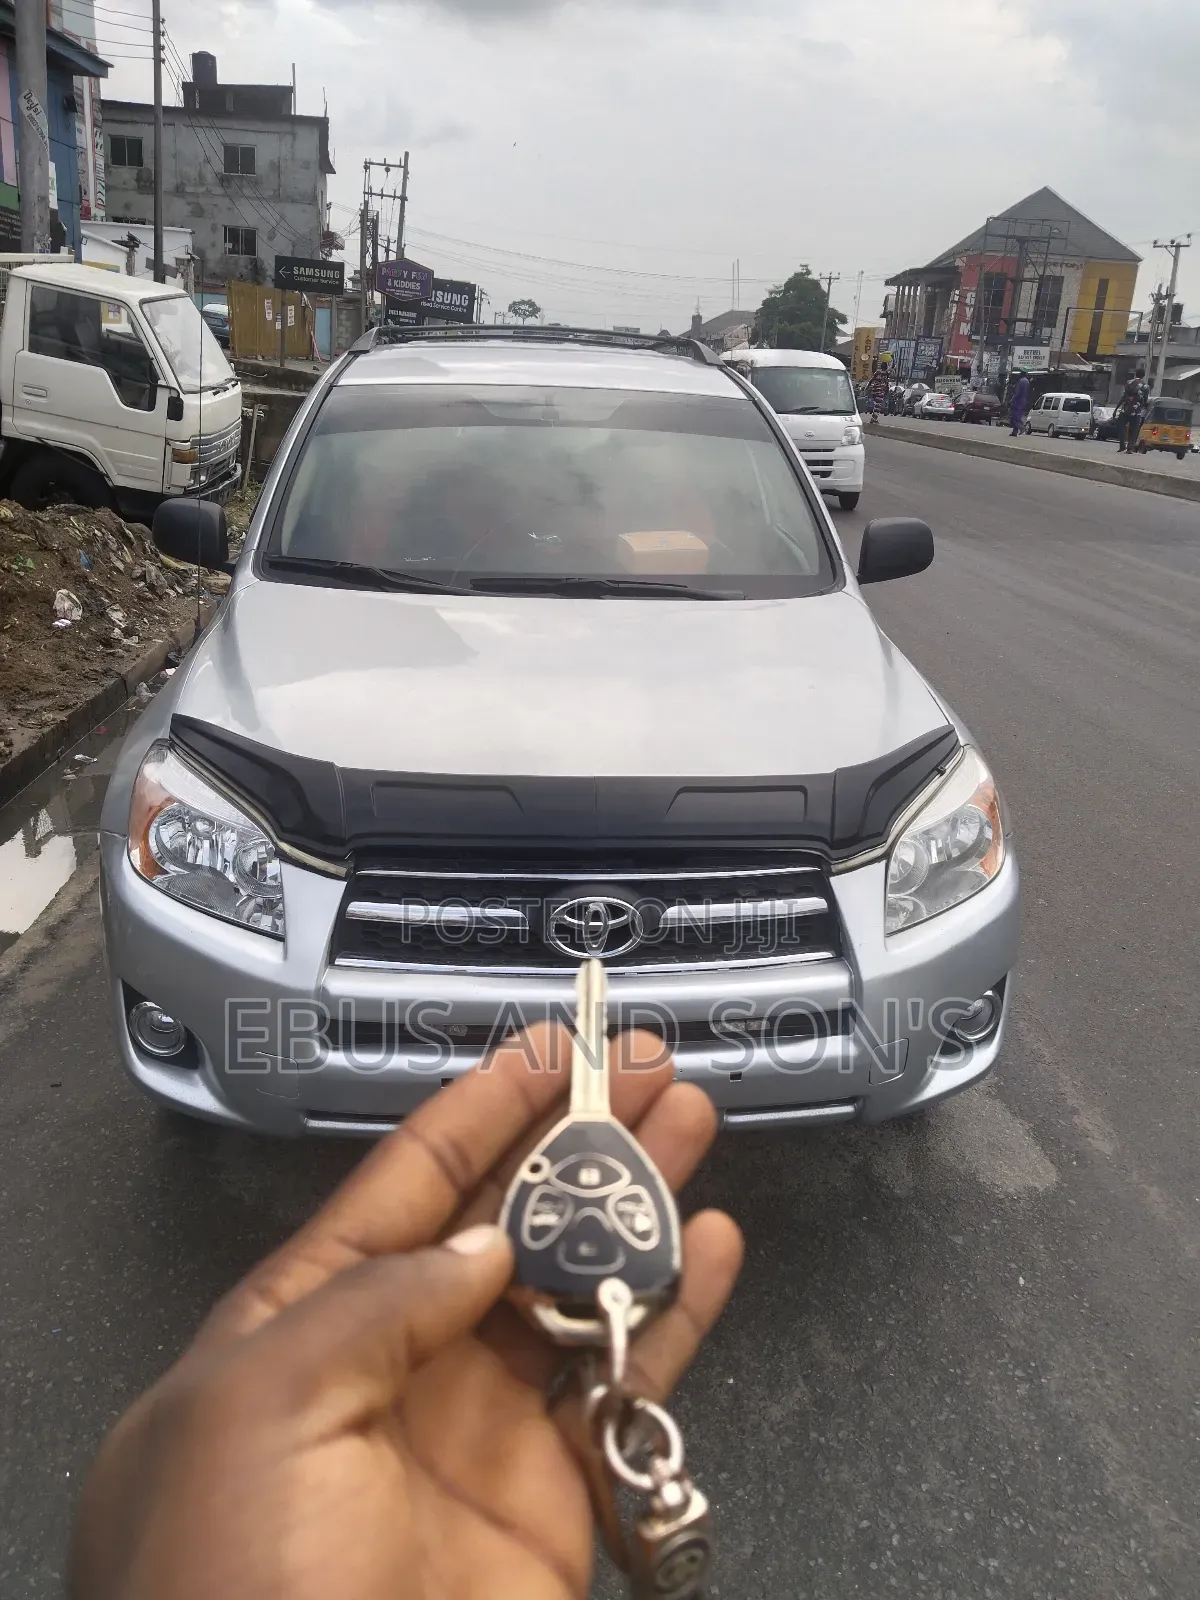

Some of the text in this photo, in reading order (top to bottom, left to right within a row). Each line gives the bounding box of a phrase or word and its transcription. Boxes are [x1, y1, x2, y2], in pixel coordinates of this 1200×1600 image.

[293, 266, 340, 279] SAMSUNG
[293, 275, 319, 283] Customer
[393, 279, 421, 290] KIDDIES
[428, 289, 469, 307] SUNG
[433, 301, 451, 311] Service
